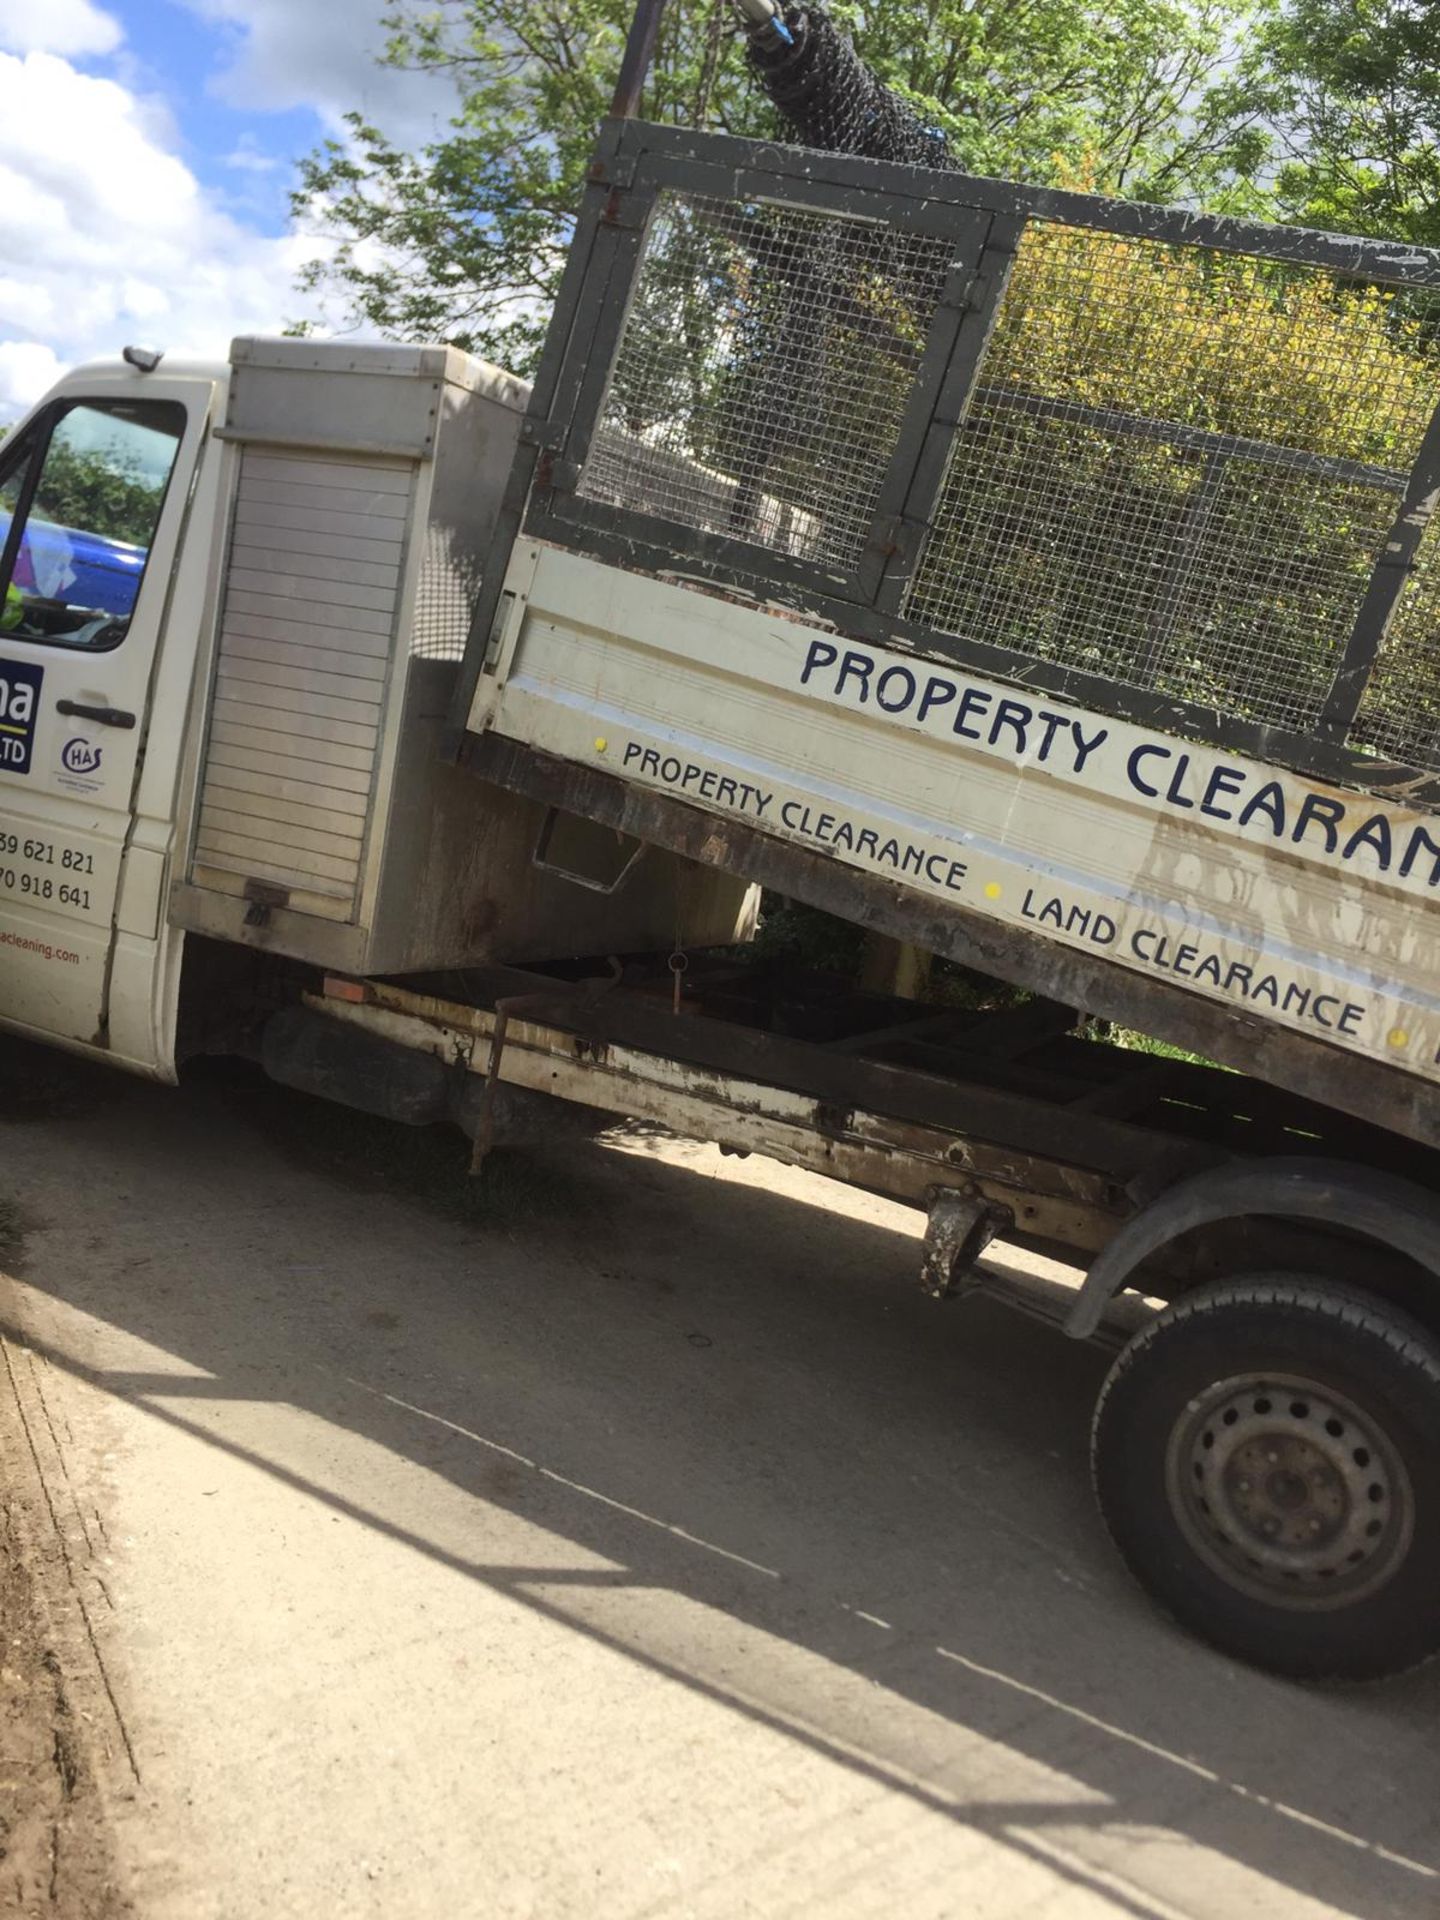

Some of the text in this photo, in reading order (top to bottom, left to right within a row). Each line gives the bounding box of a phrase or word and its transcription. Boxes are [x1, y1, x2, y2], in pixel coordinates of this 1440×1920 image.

[800, 640, 1108, 773] PROPERTY
[0, 737, 25, 763] TD
[62, 738, 103, 774] CHAS
[23, 839, 54, 864] 621
[61, 849, 94, 875] 821
[20, 874, 53, 899] 918
[59, 884, 90, 910] 641
[623, 742, 1365, 1035] PROPERTY CLEARANCE LAND CLEARANCE
